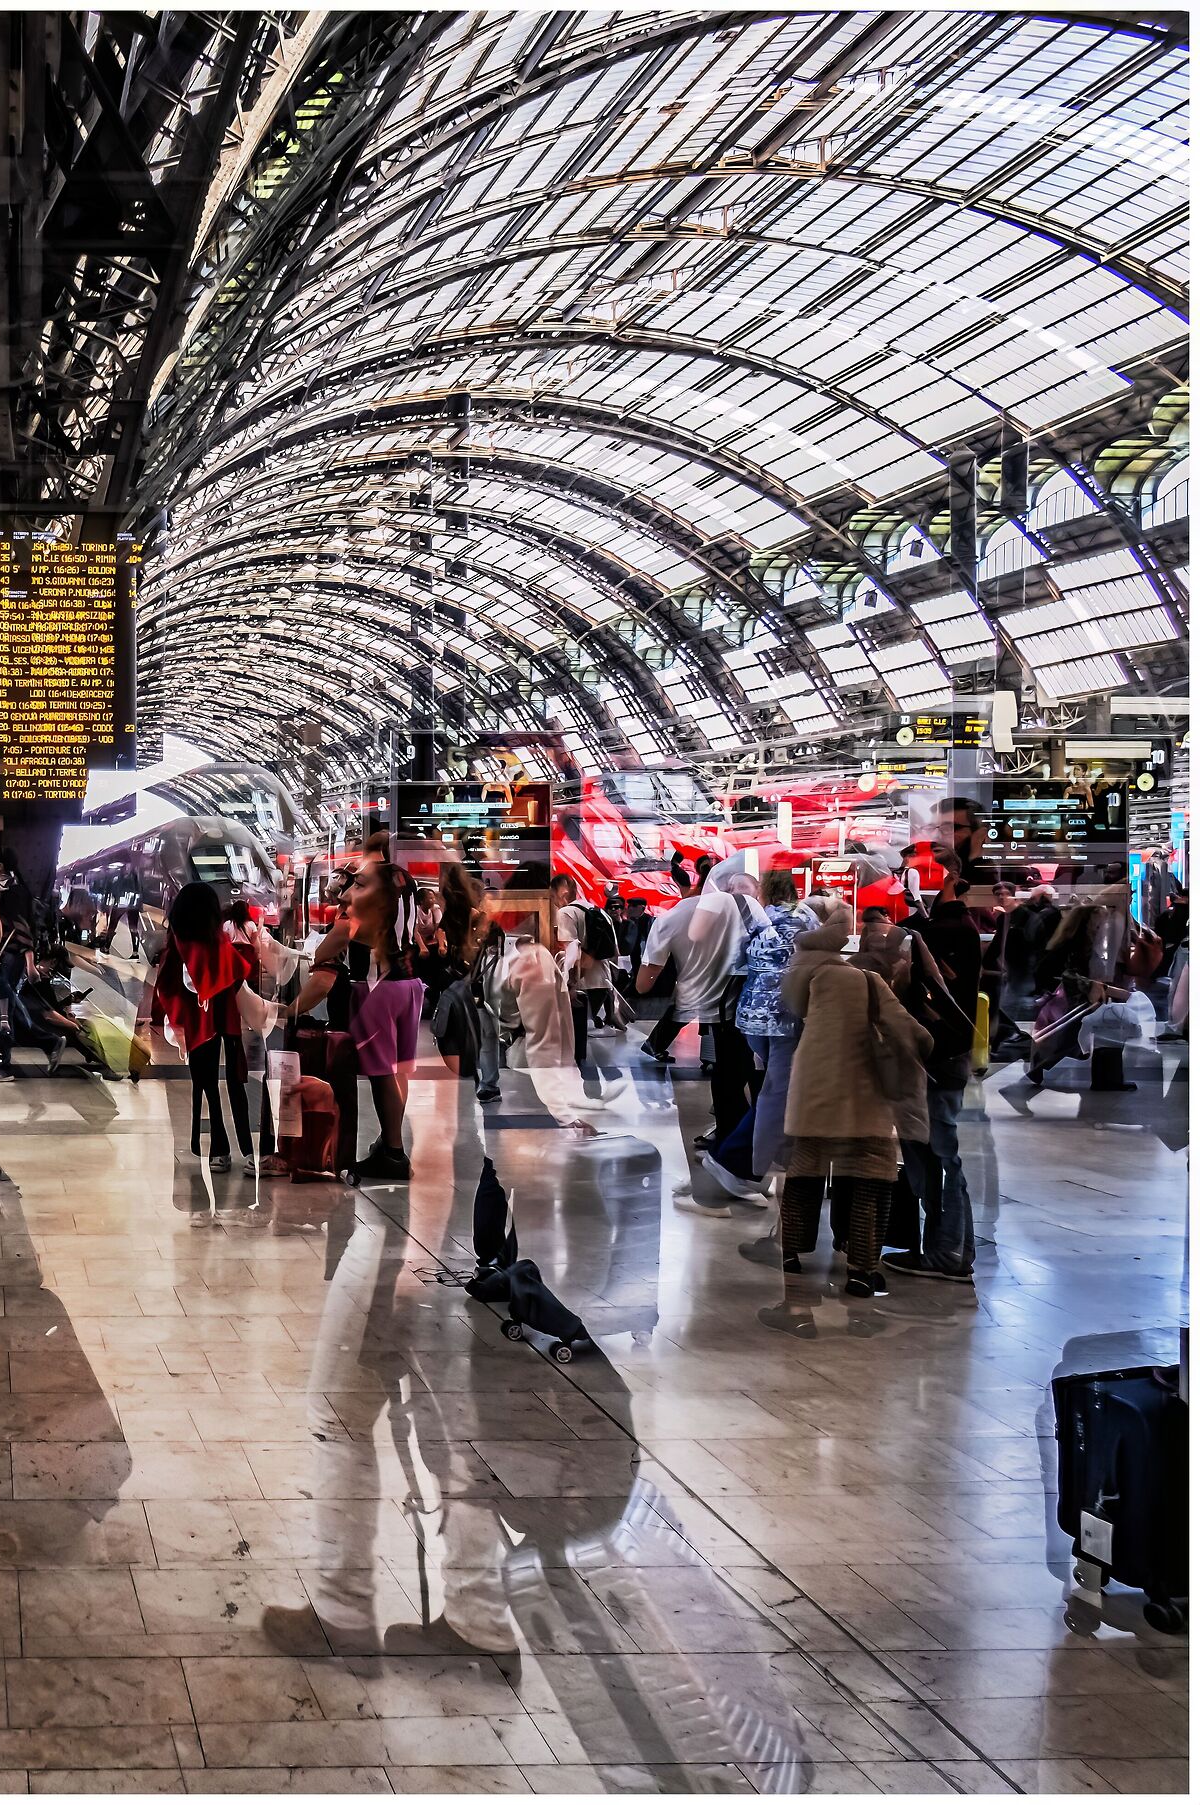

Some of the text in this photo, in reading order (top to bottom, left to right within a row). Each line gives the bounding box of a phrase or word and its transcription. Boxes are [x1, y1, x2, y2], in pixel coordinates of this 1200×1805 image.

[81, 543, 108, 552] TORINO
[43, 555, 60, 564] C.LE
[61, 555, 88, 564] (16:50)
[54, 566, 80, 574] (16:26)
[46, 578, 86, 586] S.GIOVANNI
[88, 578, 114, 586] (16:23)
[39, 588, 66, 597] VERONA
[60, 600, 86, 608] (16:38)
[80, 702, 106, 710] (19:25)
[124, 724, 135, 732] 23
[30, 747, 72, 755] PONTENURE
[406, 744, 416, 760] 9
[1151, 749, 1166, 764] 10
[20, 758, 56, 766] AFRAGOLA
[58, 758, 86, 766] (20:38)
[16, 768, 48, 777] BELLANO
[49, 768, 78, 777] T.TERME
[6, 780, 30, 788] (17:01)
[38, 780, 60, 788] PONTE
[12, 790, 36, 799] (17:16)
[44, 790, 76, 799] TORTONA
[377, 796, 387, 812] 9
[1106, 792, 1121, 808] 10
